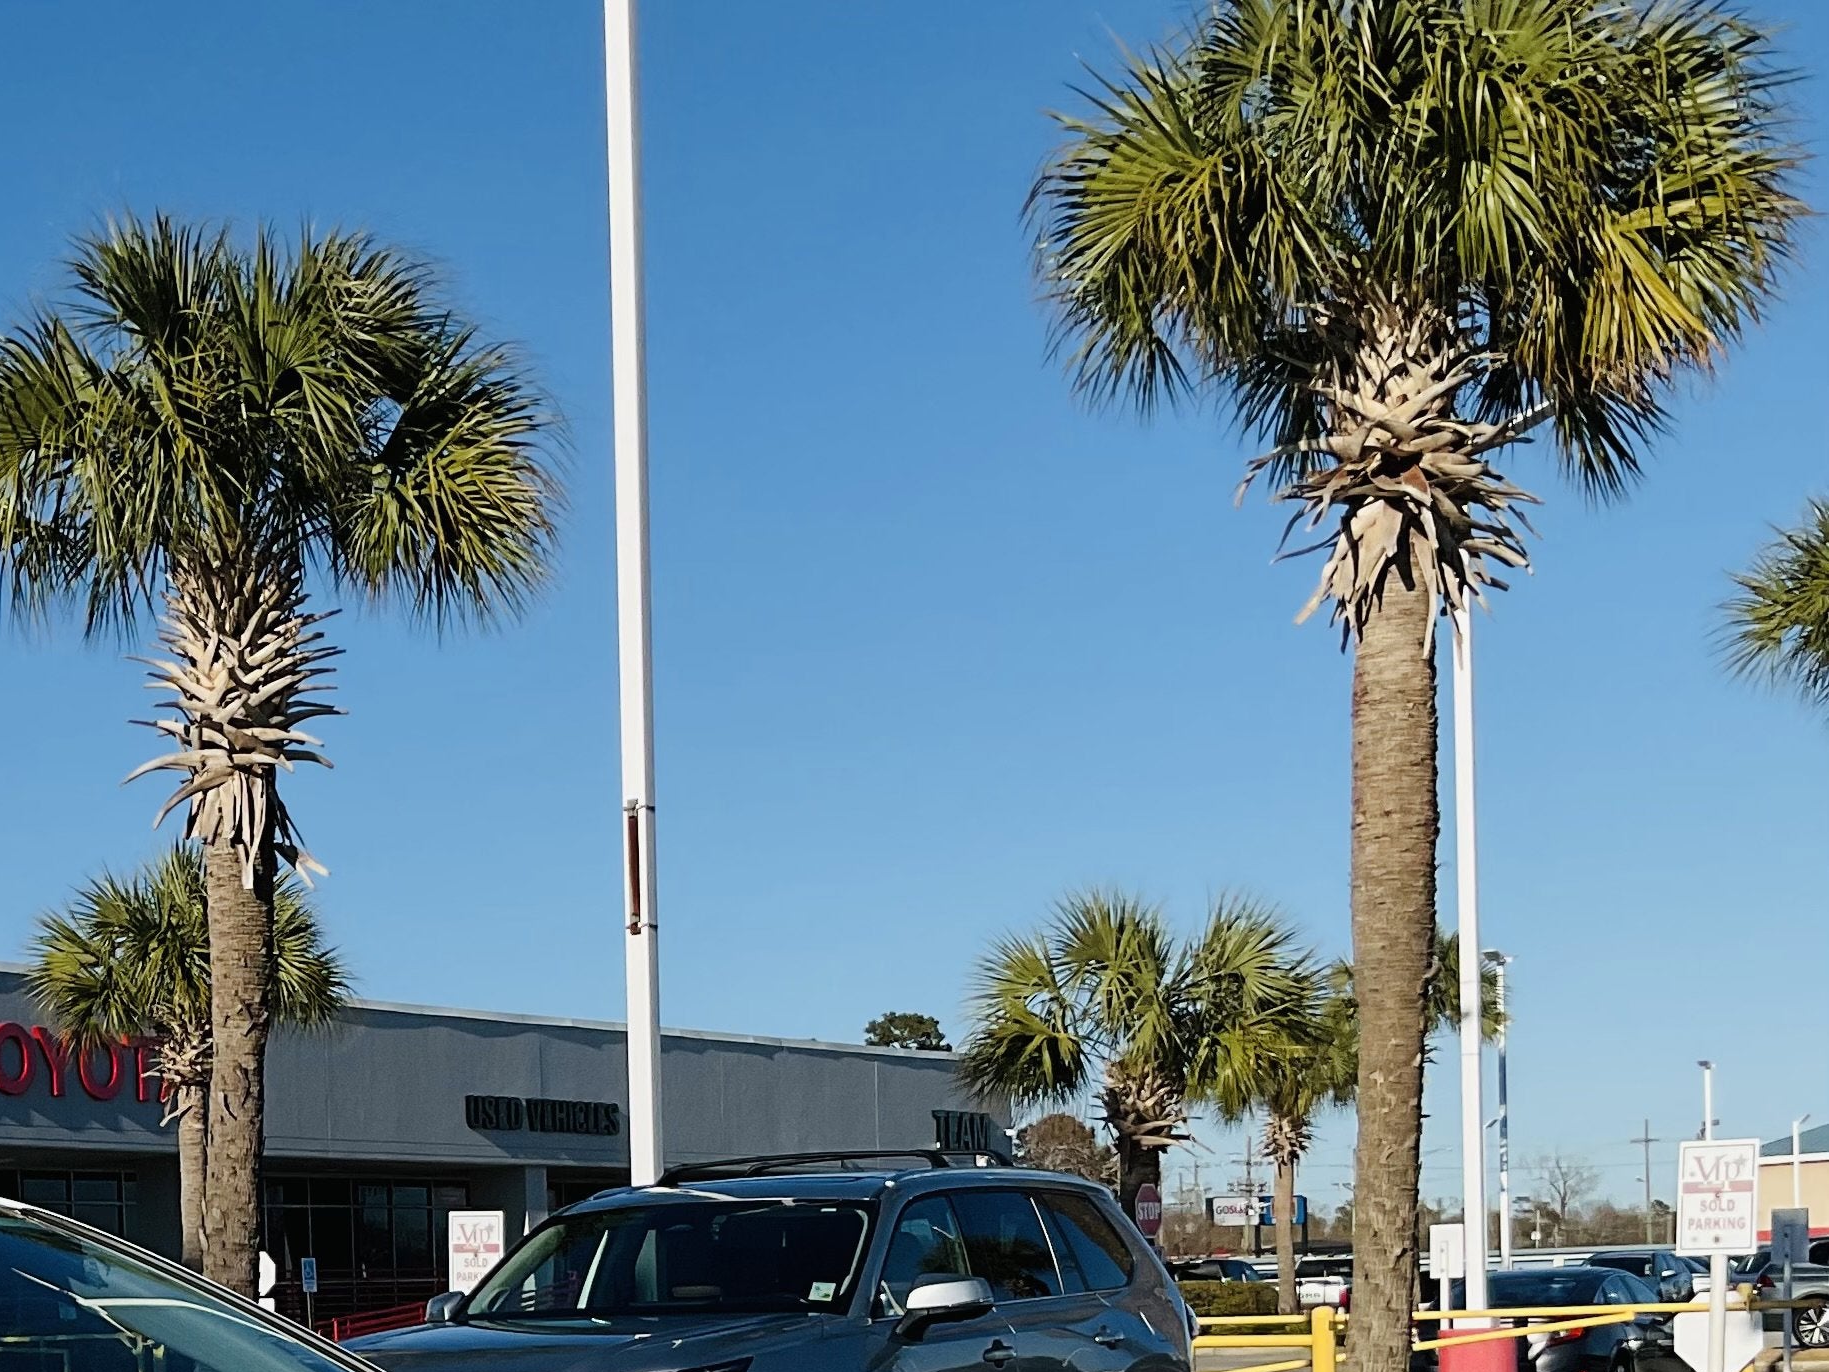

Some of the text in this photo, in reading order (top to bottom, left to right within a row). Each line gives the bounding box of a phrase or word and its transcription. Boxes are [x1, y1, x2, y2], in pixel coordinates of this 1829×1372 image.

[465, 1094, 620, 1136] USED VEHICLES
[931, 1109, 990, 1151] TEAM
[1137, 1202, 1160, 1220] STOP
[1700, 1199, 1735, 1213] SOLD
[1687, 1216, 1746, 1231] PARKING
[463, 1257, 488, 1268] SOLD
[456, 1271, 482, 1282] PARK
